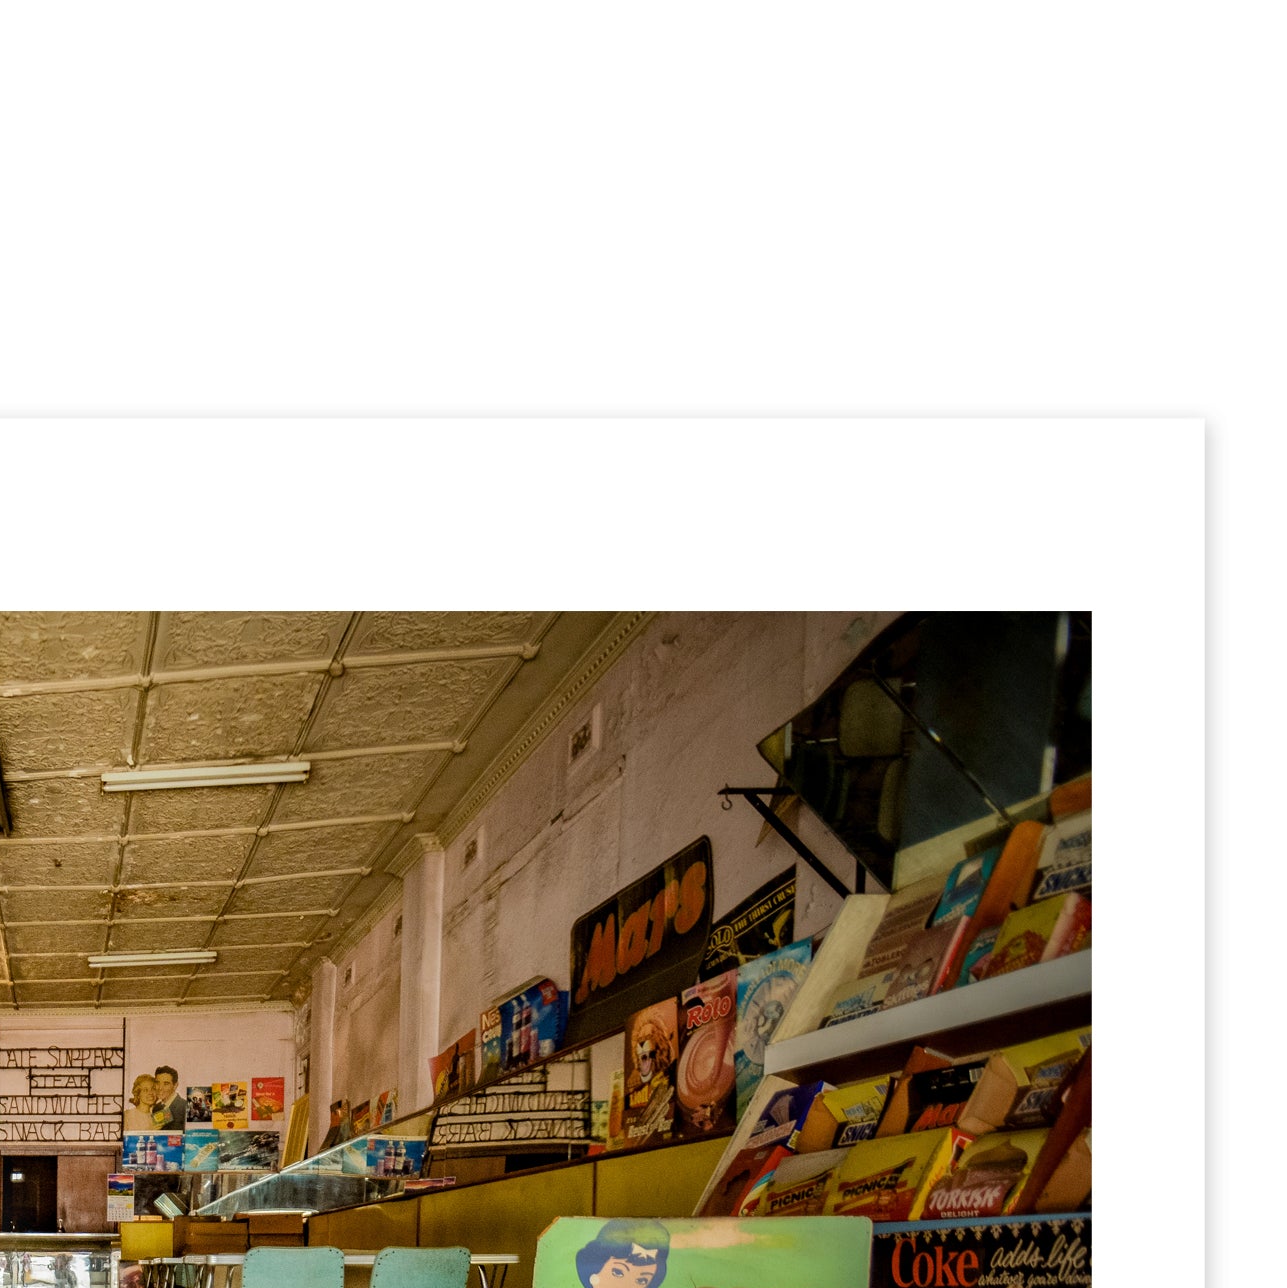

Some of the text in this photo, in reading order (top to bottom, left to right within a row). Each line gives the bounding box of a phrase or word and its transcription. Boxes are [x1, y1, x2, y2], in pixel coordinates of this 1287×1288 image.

[573, 861, 707, 1005] Mars
[31, 1075, 90, 1088] STEAK
[79, 1122, 122, 1141] BAR
[769, 1187, 814, 1210] PICNIC
[842, 1177, 888, 1200] PICNIC
[928, 1186, 1003, 1210] TURKISH
[939, 1209, 980, 1220] DELIGHT
[891, 1233, 1085, 1288] Coke adds life
